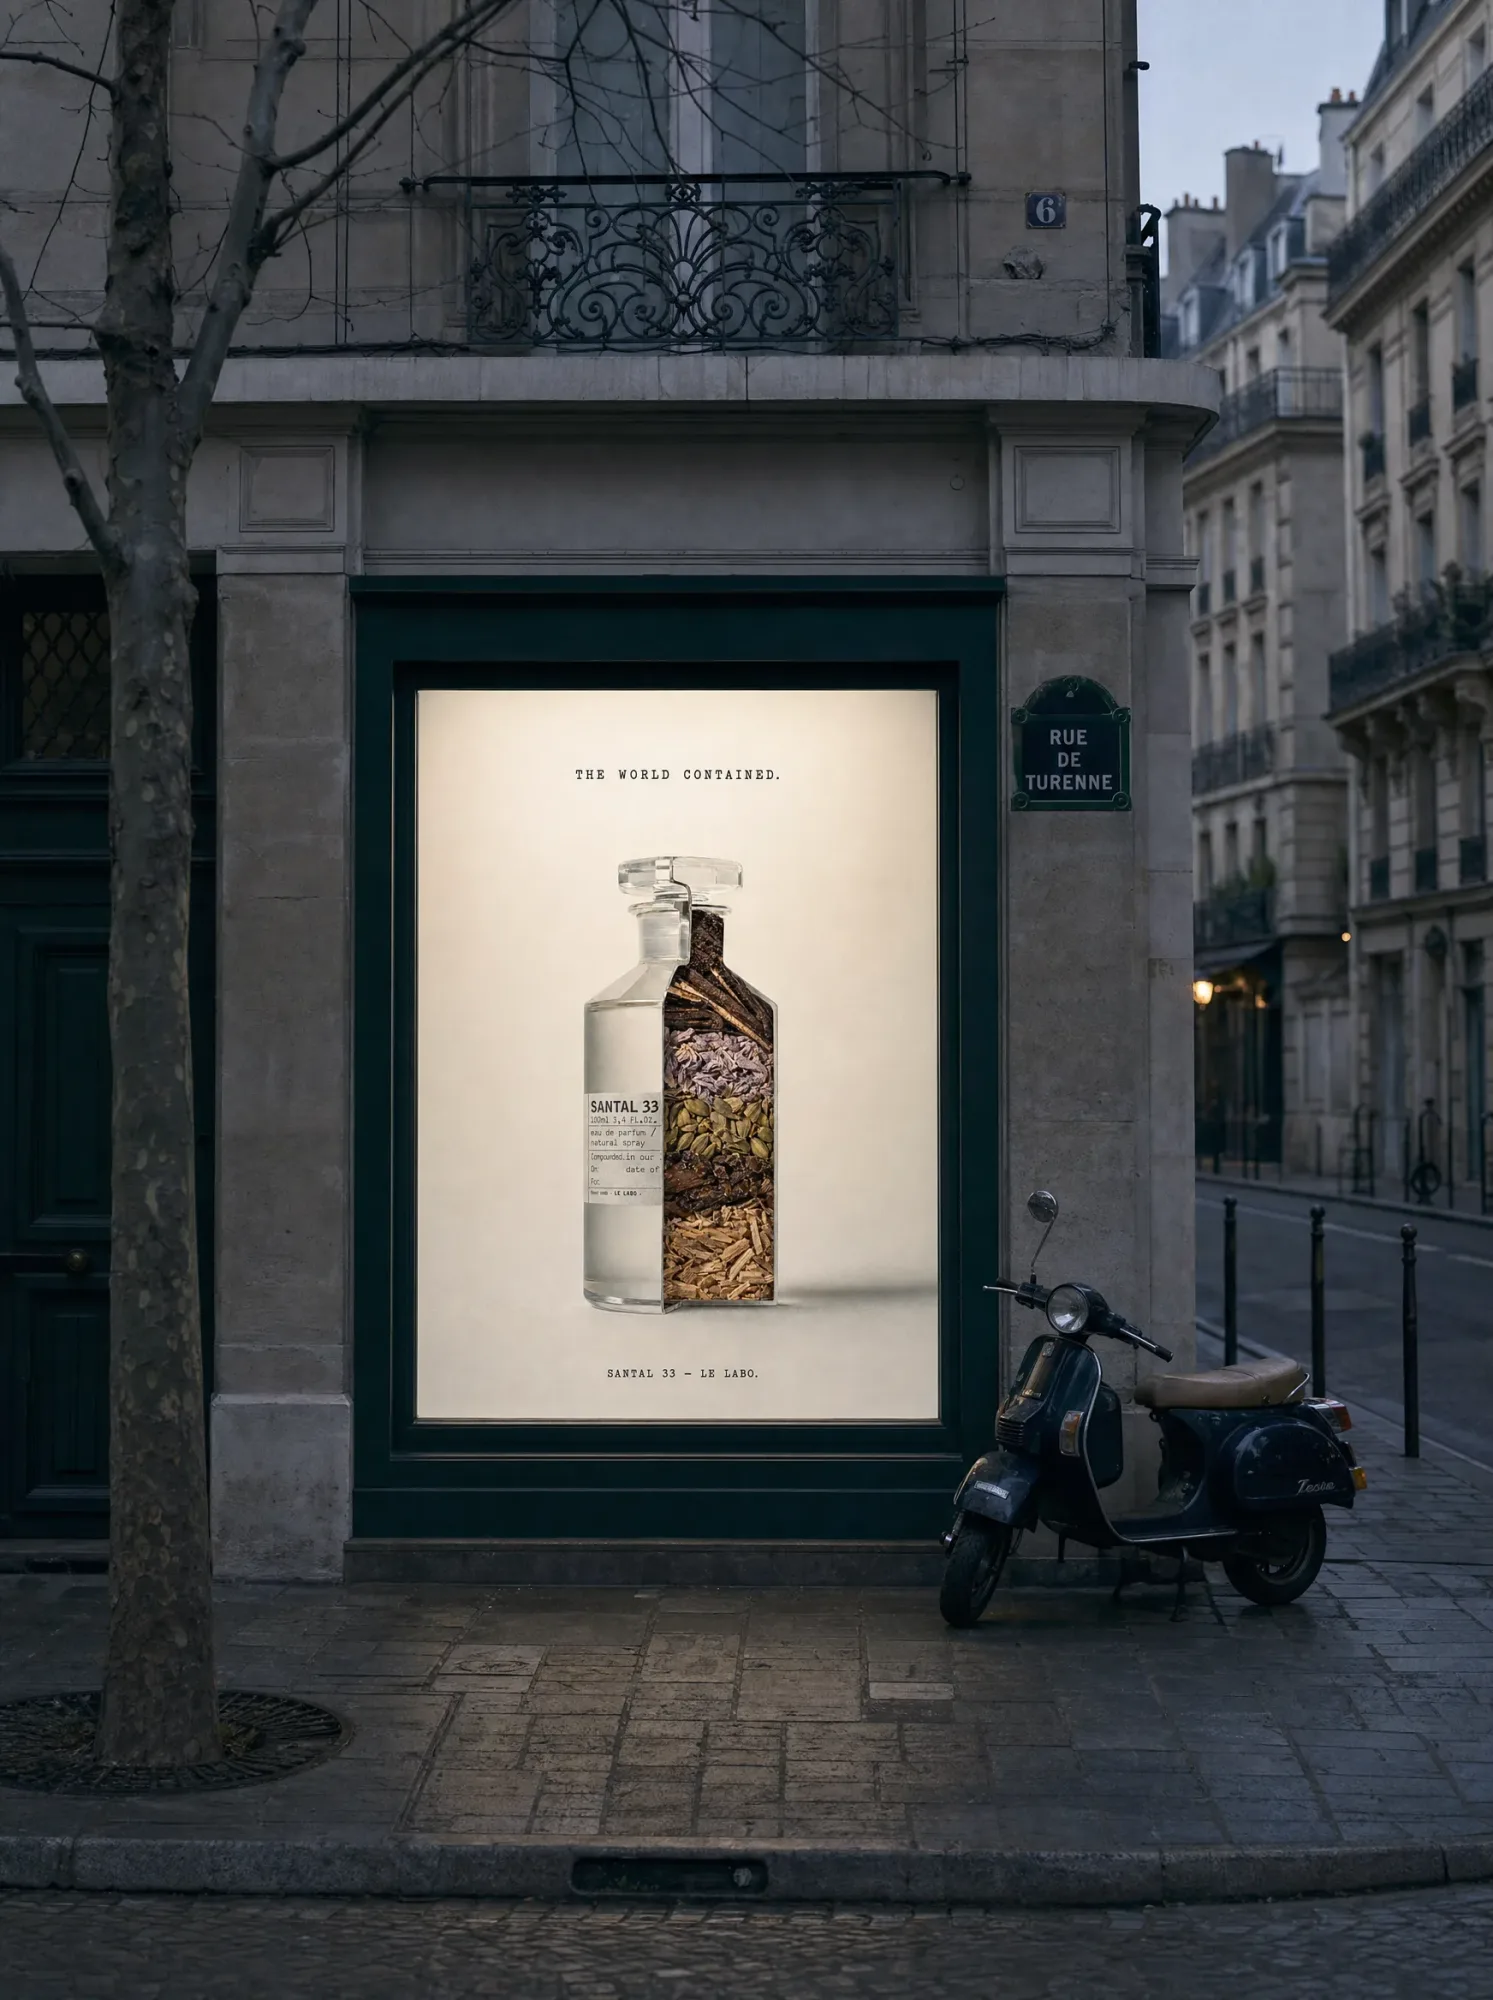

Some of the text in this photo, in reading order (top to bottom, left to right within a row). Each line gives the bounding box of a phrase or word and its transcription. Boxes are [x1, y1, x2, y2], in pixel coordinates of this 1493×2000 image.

[1036, 197, 1056, 223] 6
[1050, 729, 1088, 745] RUE
[1058, 752, 1081, 767] DE
[575, 769, 780, 780] THE WORLD CONTAINED.
[1025, 774, 1113, 790] TURENNE
[590, 1100, 659, 1113] SANTAL 33
[618, 1129, 647, 1137] parfum
[590, 1139, 646, 1148] natural spray
[649, 1165, 661, 1173] of
[607, 1369, 654, 1378] SANTAL
[662, 1369, 676, 1378] 33
[700, 1369, 715, 1378] LE
[724, 1369, 758, 1378] LABO.
